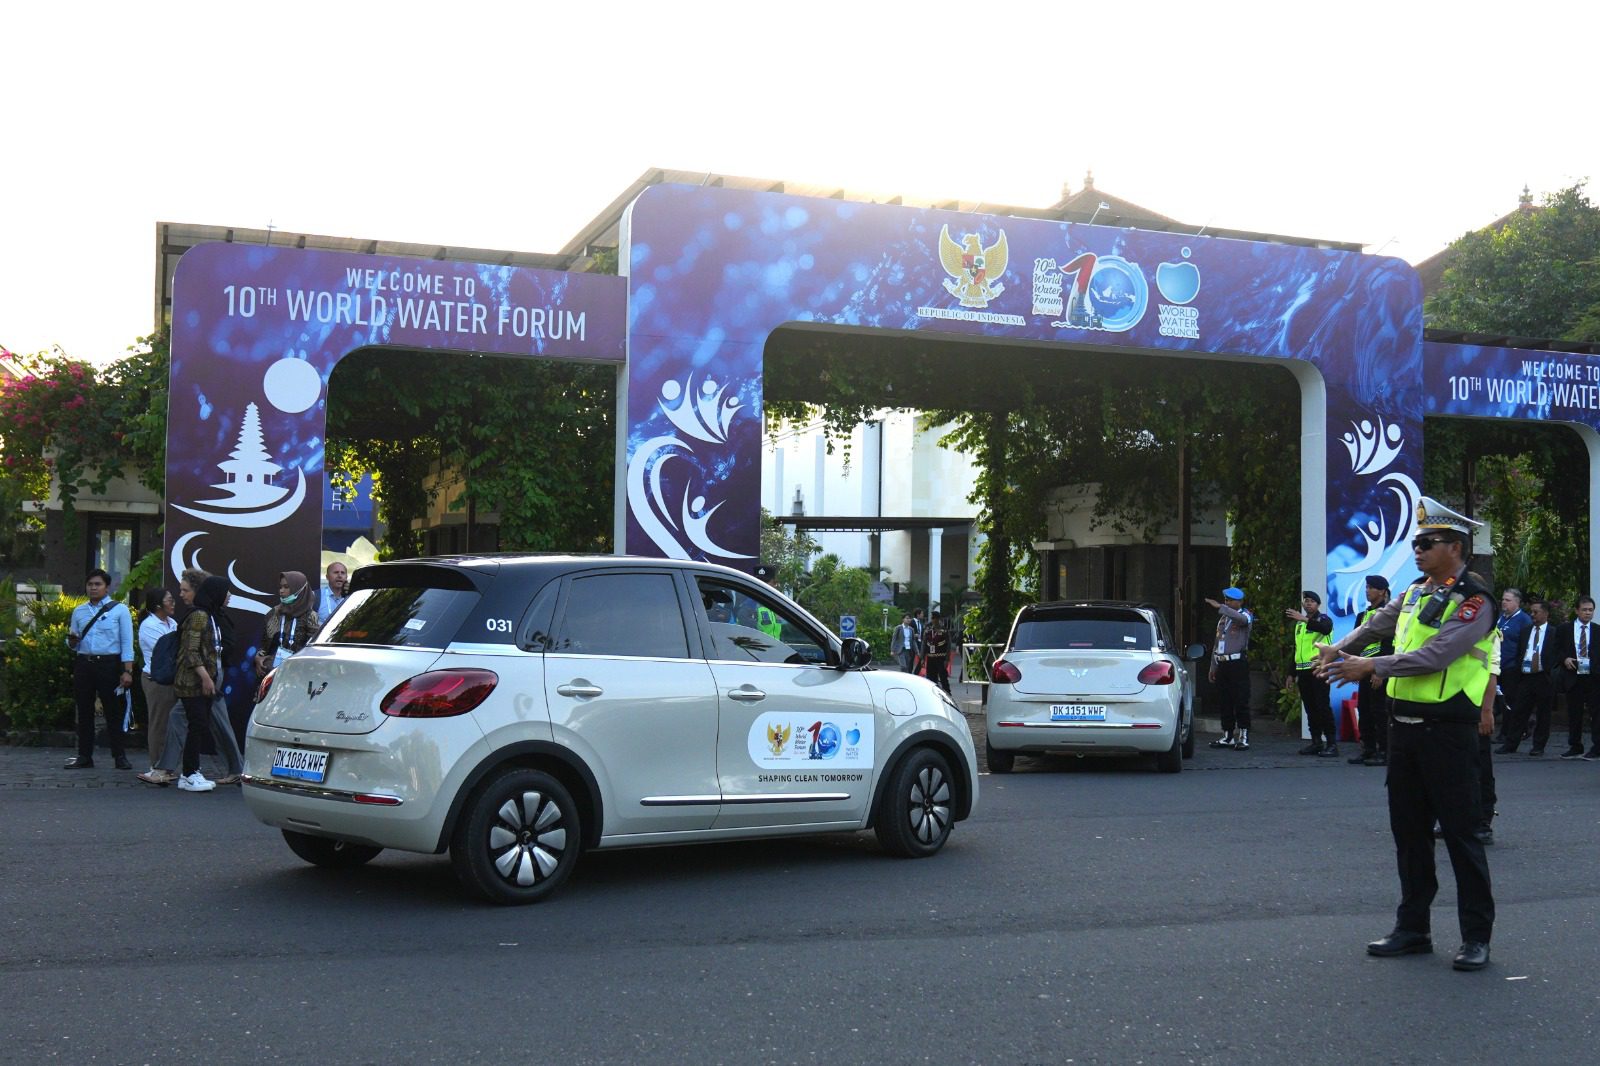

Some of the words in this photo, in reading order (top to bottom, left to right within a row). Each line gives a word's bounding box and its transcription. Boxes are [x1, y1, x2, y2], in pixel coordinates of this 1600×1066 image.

[1034, 259, 1055, 272] 10th
[346, 267, 444, 295] WELCOME
[453, 276, 475, 297] TO
[1034, 273, 1061, 284] World
[1034, 284, 1062, 294] Water
[1034, 294, 1062, 305] Forum
[223, 285, 277, 318] 10TH
[286, 289, 387, 327] WORLD
[396, 297, 488, 334] WATER
[498, 305, 586, 341] FORUM
[919, 308, 961, 319] REPUBLIC
[963, 312, 975, 320] OF
[977, 313, 1025, 324] INDONESIA
[1160, 304, 1198, 318] WORLD
[1160, 316, 1197, 328] WATER
[1160, 326, 1198, 337] COUNCIL
[1521, 360, 1582, 381] WELCOME
[1586, 365, 1600, 382] TO
[1448, 376, 1482, 400] 10TH
[1486, 378, 1548, 406] WORLD
[1552, 382, 1600, 410] WATE
[486, 618, 513, 633] 031
[1053, 706, 1064, 716] DK
[1065, 706, 1086, 716] 1151
[1088, 706, 1105, 716] WWF
[274, 750, 287, 767] DK
[285, 751, 308, 770] 1086
[307, 753, 326, 772] WWF
[758, 774, 792, 783] SHAPING
[794, 774, 818, 783] CLEAN
[820, 774, 863, 783] TOMORROW
